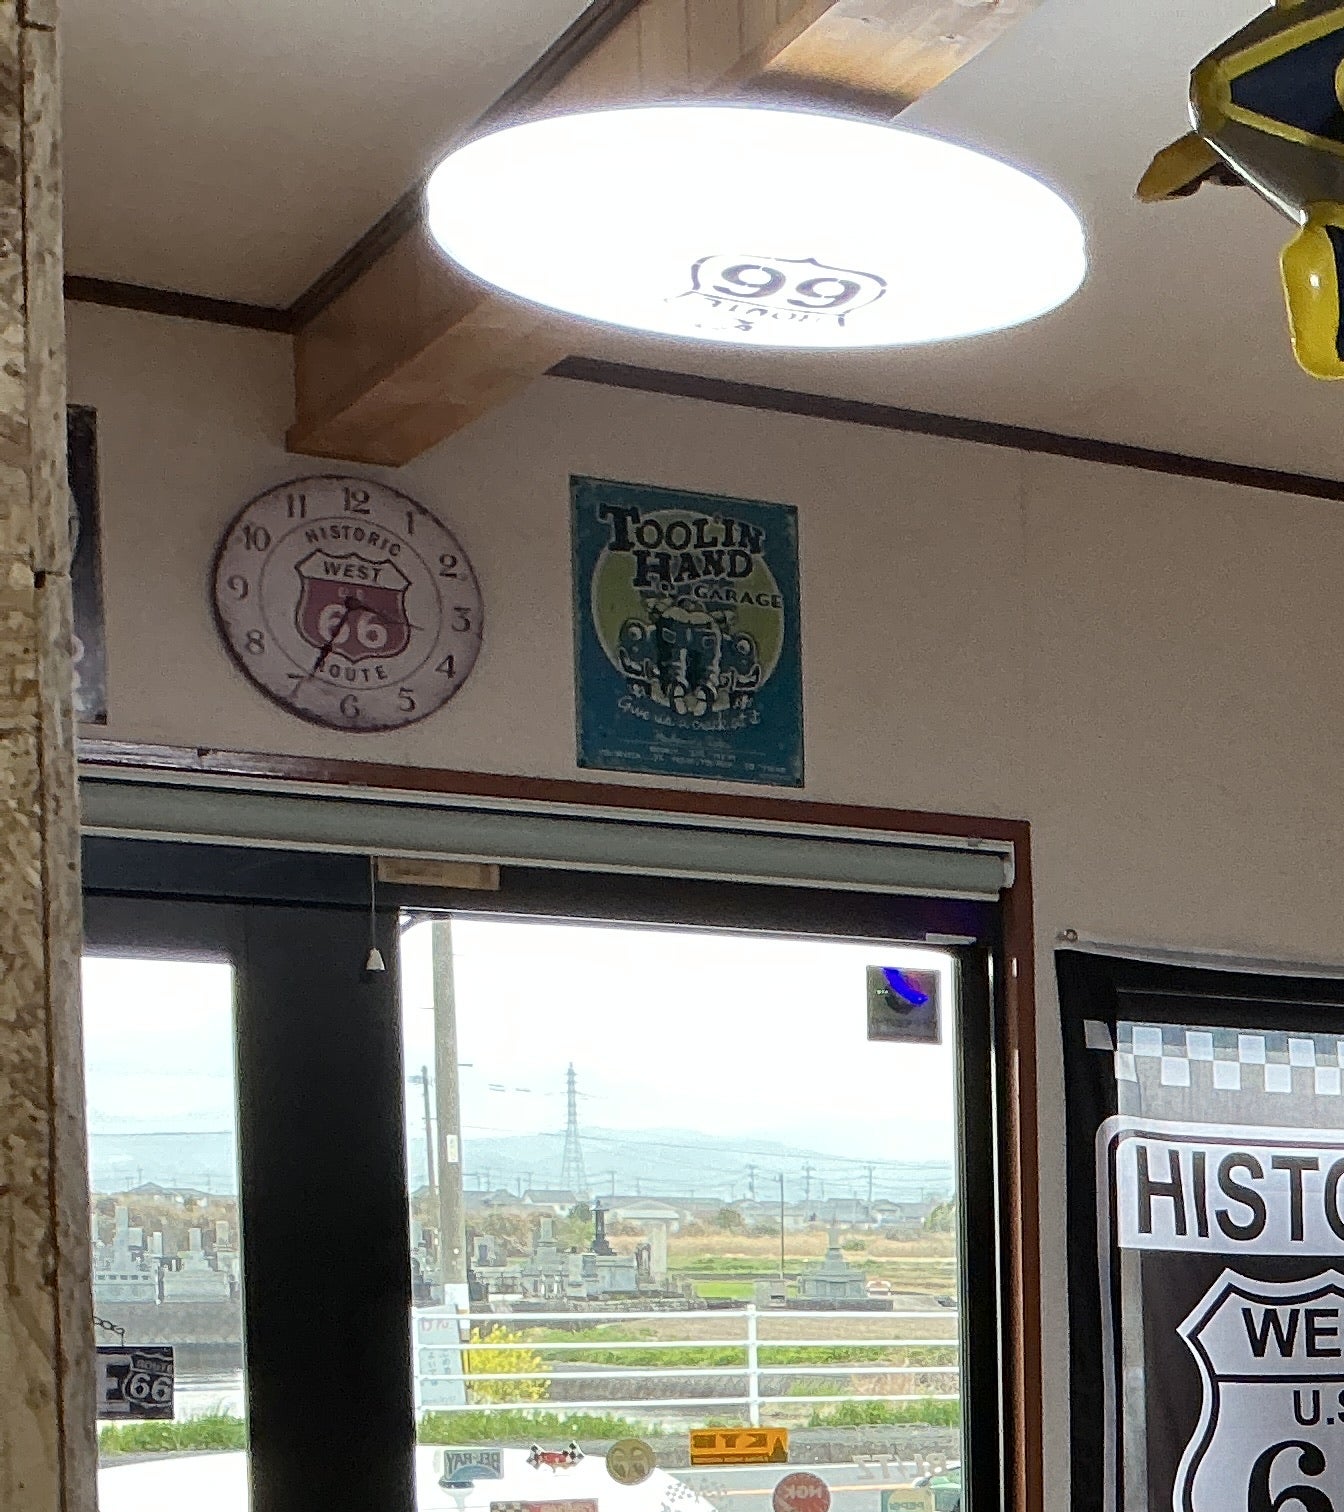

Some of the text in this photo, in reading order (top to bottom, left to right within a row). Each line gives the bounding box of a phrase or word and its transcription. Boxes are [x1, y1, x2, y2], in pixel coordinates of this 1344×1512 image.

[305, 525, 401, 557] HISTORIC
[323, 561, 383, 583] WEST
[633, 549, 753, 588] HAND
[694, 585, 784, 610] GARAGE
[319, 603, 388, 649] 66
[315, 660, 388, 683] OUTE
[130, 1373, 173, 1402] 66
